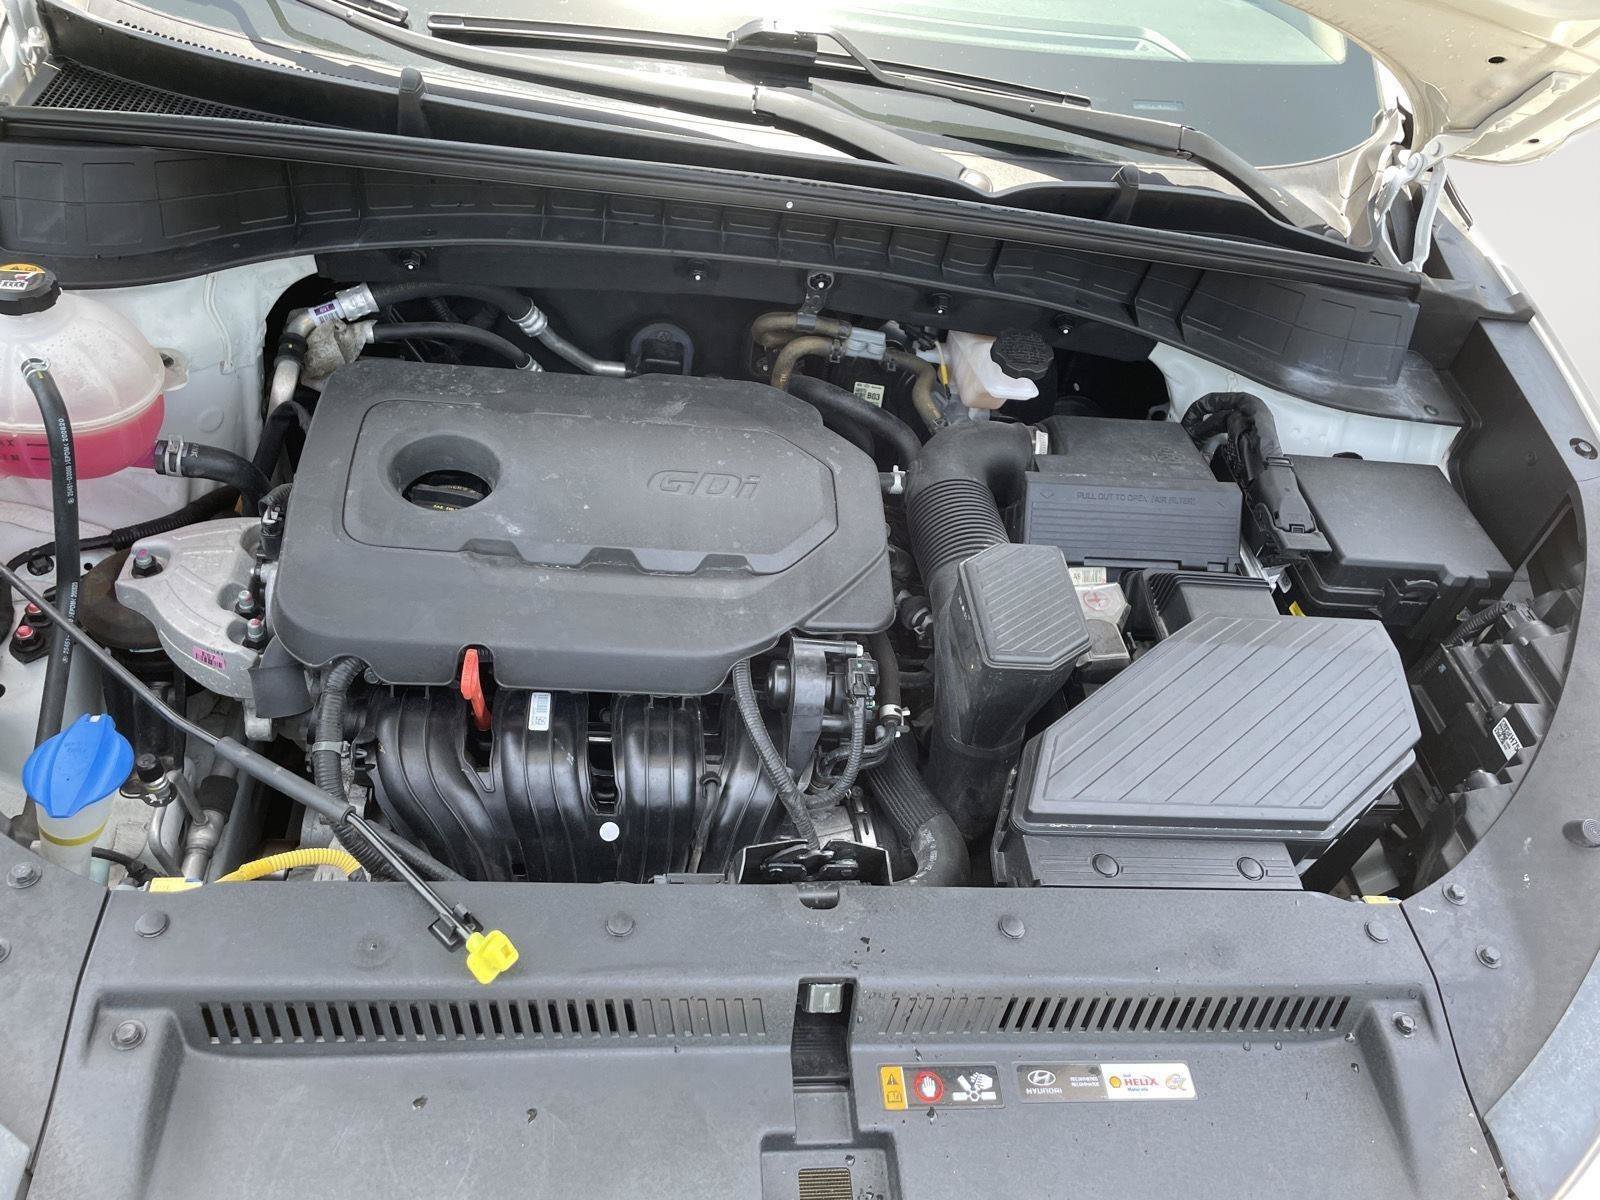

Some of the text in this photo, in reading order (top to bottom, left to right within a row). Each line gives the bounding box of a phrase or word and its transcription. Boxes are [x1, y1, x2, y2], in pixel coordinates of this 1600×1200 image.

[1076, 491, 1096, 500] PULL
[1099, 492, 1113, 501] OUT
[1113, 493, 1126, 501] TO
[1124, 1077, 1160, 1086] HELIX
[1025, 1087, 1063, 1095] HYUNDAI
